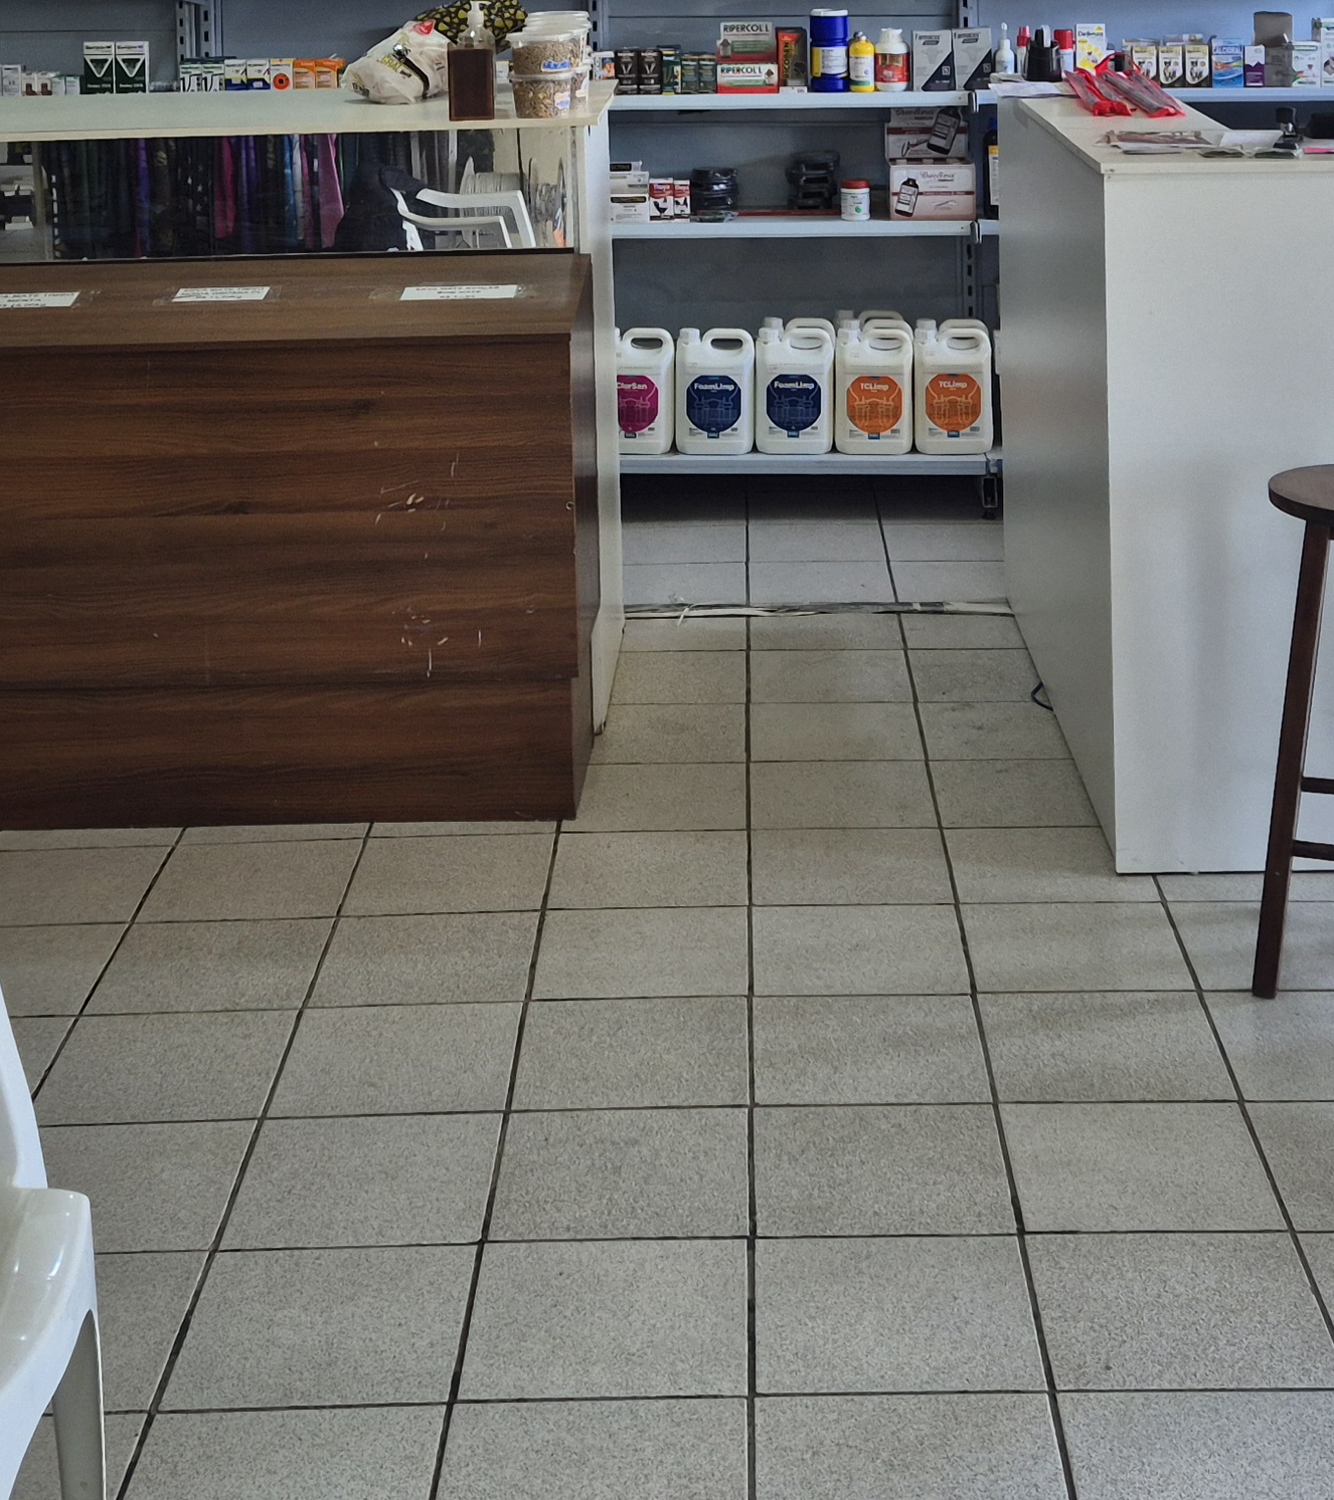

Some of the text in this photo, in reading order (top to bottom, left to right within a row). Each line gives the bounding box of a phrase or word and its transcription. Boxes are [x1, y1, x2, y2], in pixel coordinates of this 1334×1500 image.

[723, 24, 769, 33] RIPERCOL L
[720, 66, 757, 74] RIPERCOL
